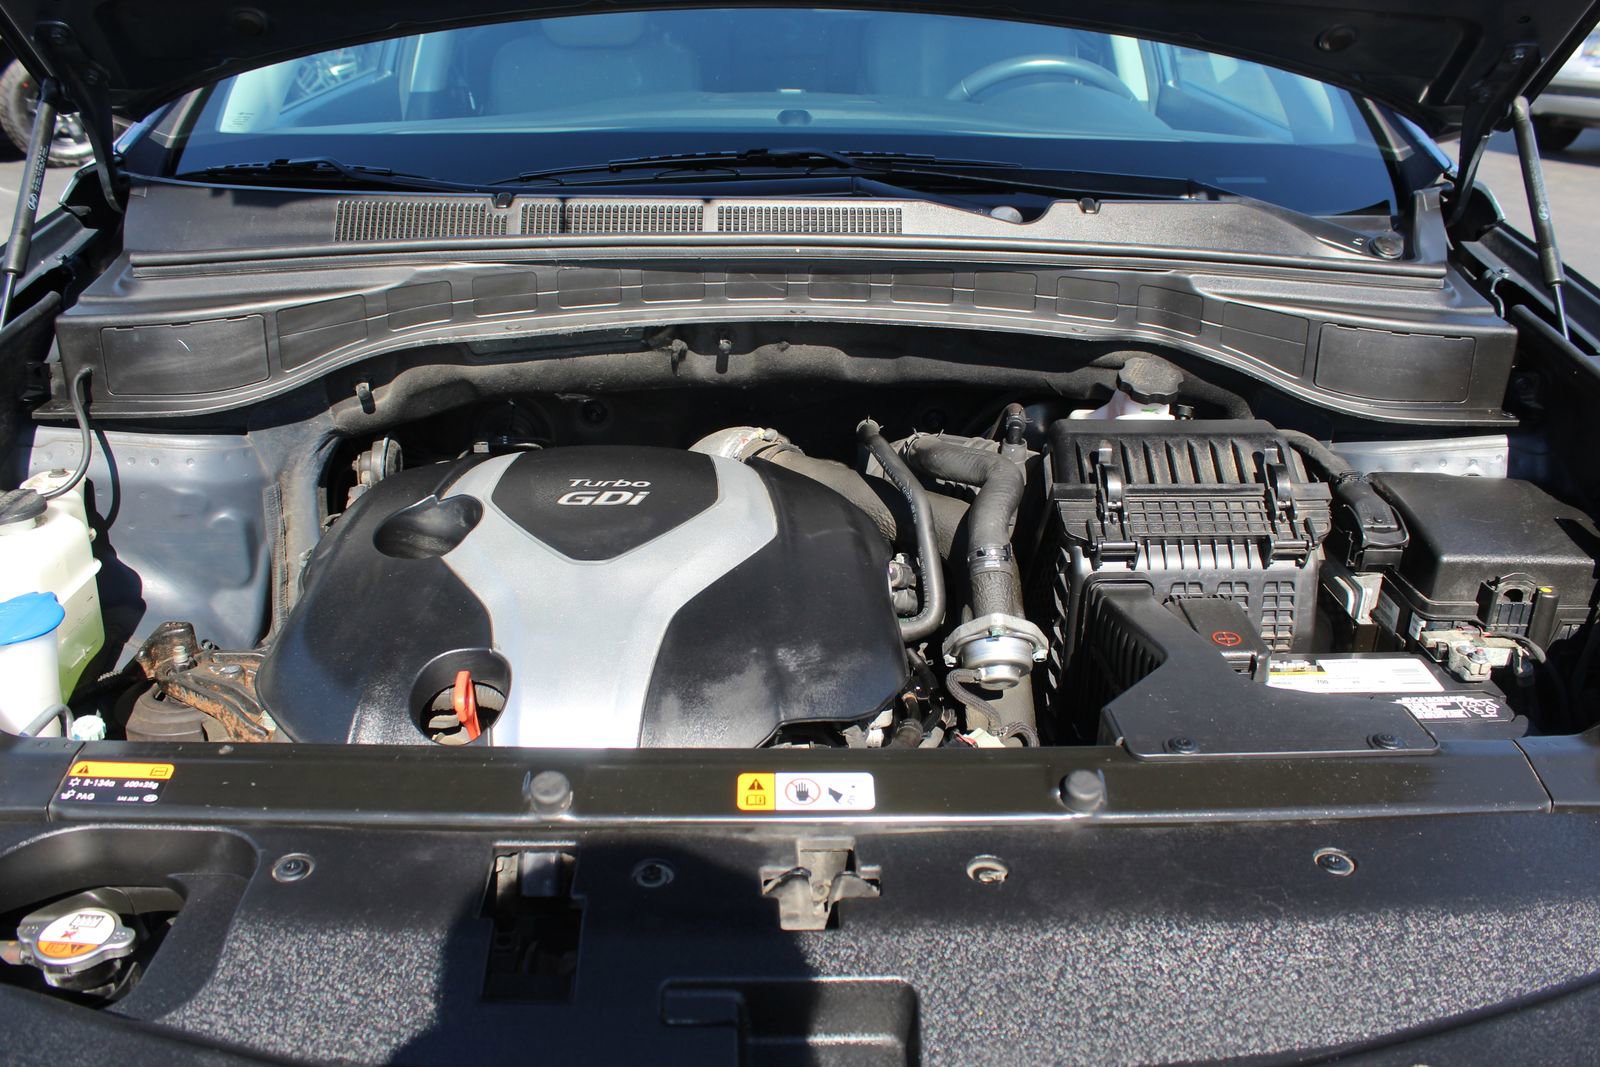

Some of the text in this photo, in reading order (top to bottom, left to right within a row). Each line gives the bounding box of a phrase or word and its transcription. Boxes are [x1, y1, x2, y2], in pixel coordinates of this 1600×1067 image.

[569, 479, 651, 487] Turbo
[557, 491, 650, 506] GDi
[82, 778, 116, 788] R-134a
[75, 792, 95, 801] PAG
